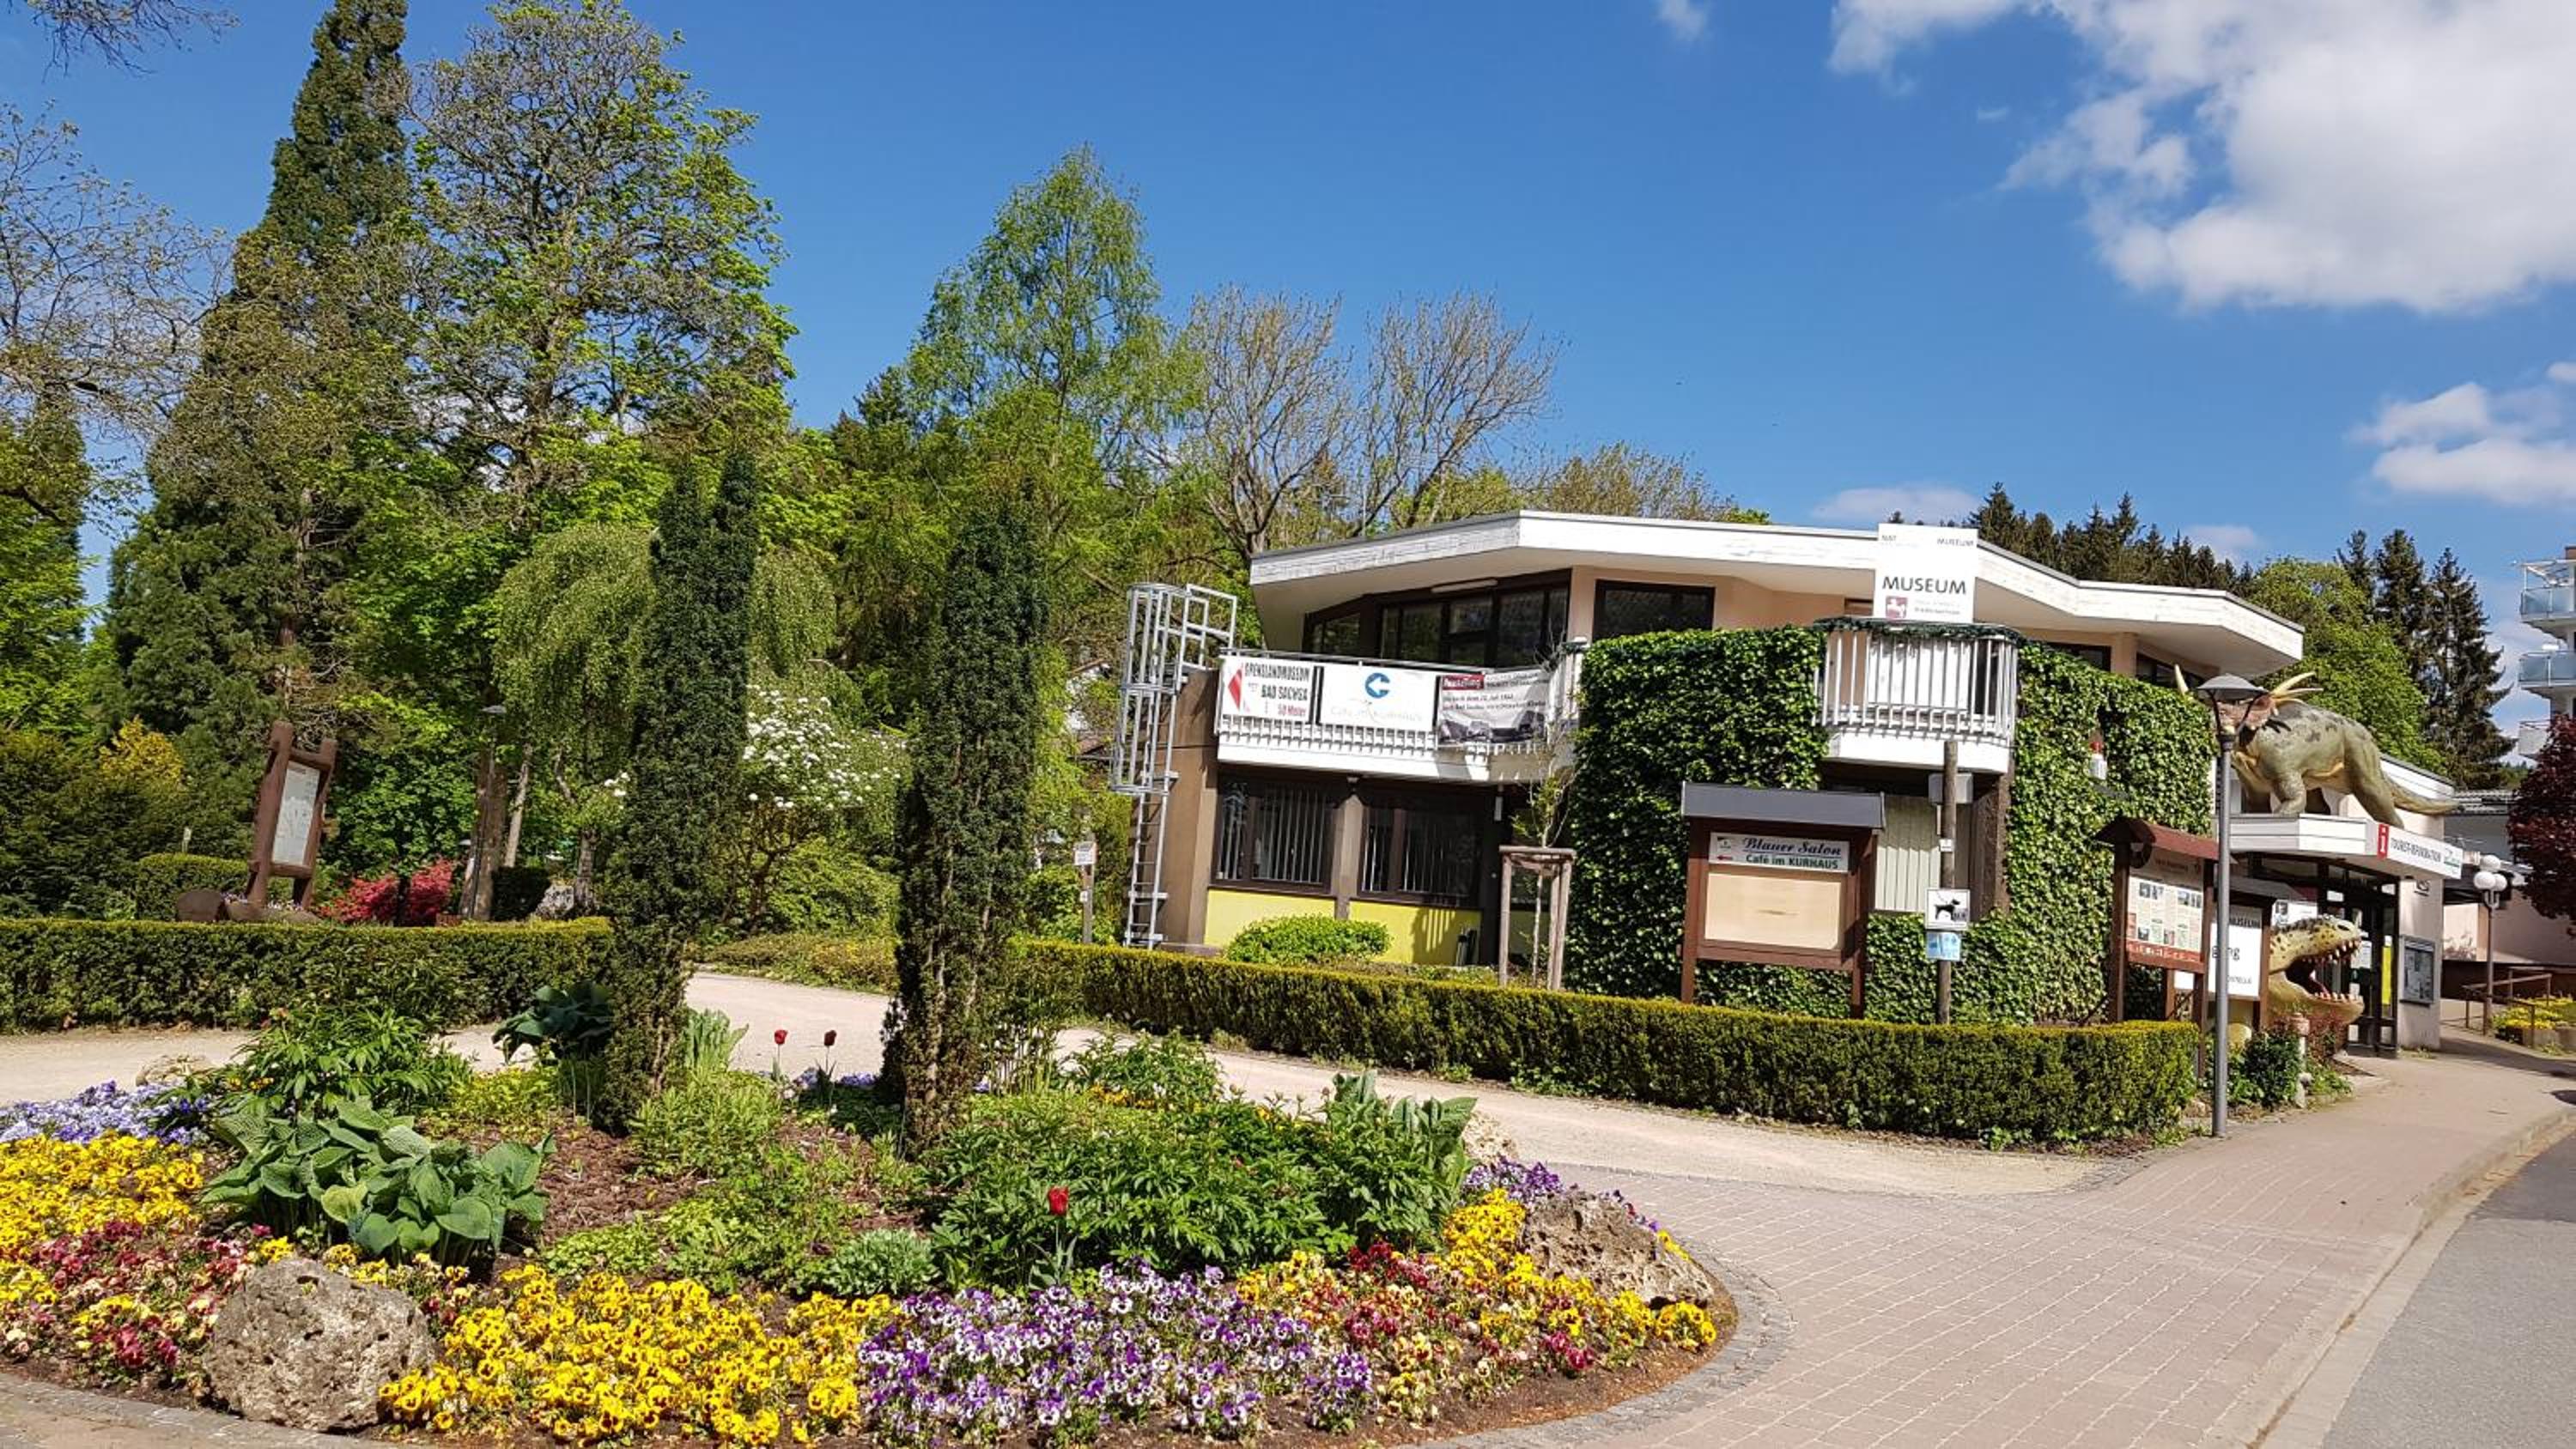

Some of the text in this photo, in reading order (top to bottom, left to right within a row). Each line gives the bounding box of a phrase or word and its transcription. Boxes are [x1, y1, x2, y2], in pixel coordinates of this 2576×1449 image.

[1882, 576, 1966, 595] MUSEUM
[1743, 837, 1794, 852] Blauer
[1798, 840, 1842, 856] Salon
[1746, 854, 1839, 870] Café im KURHAUS
